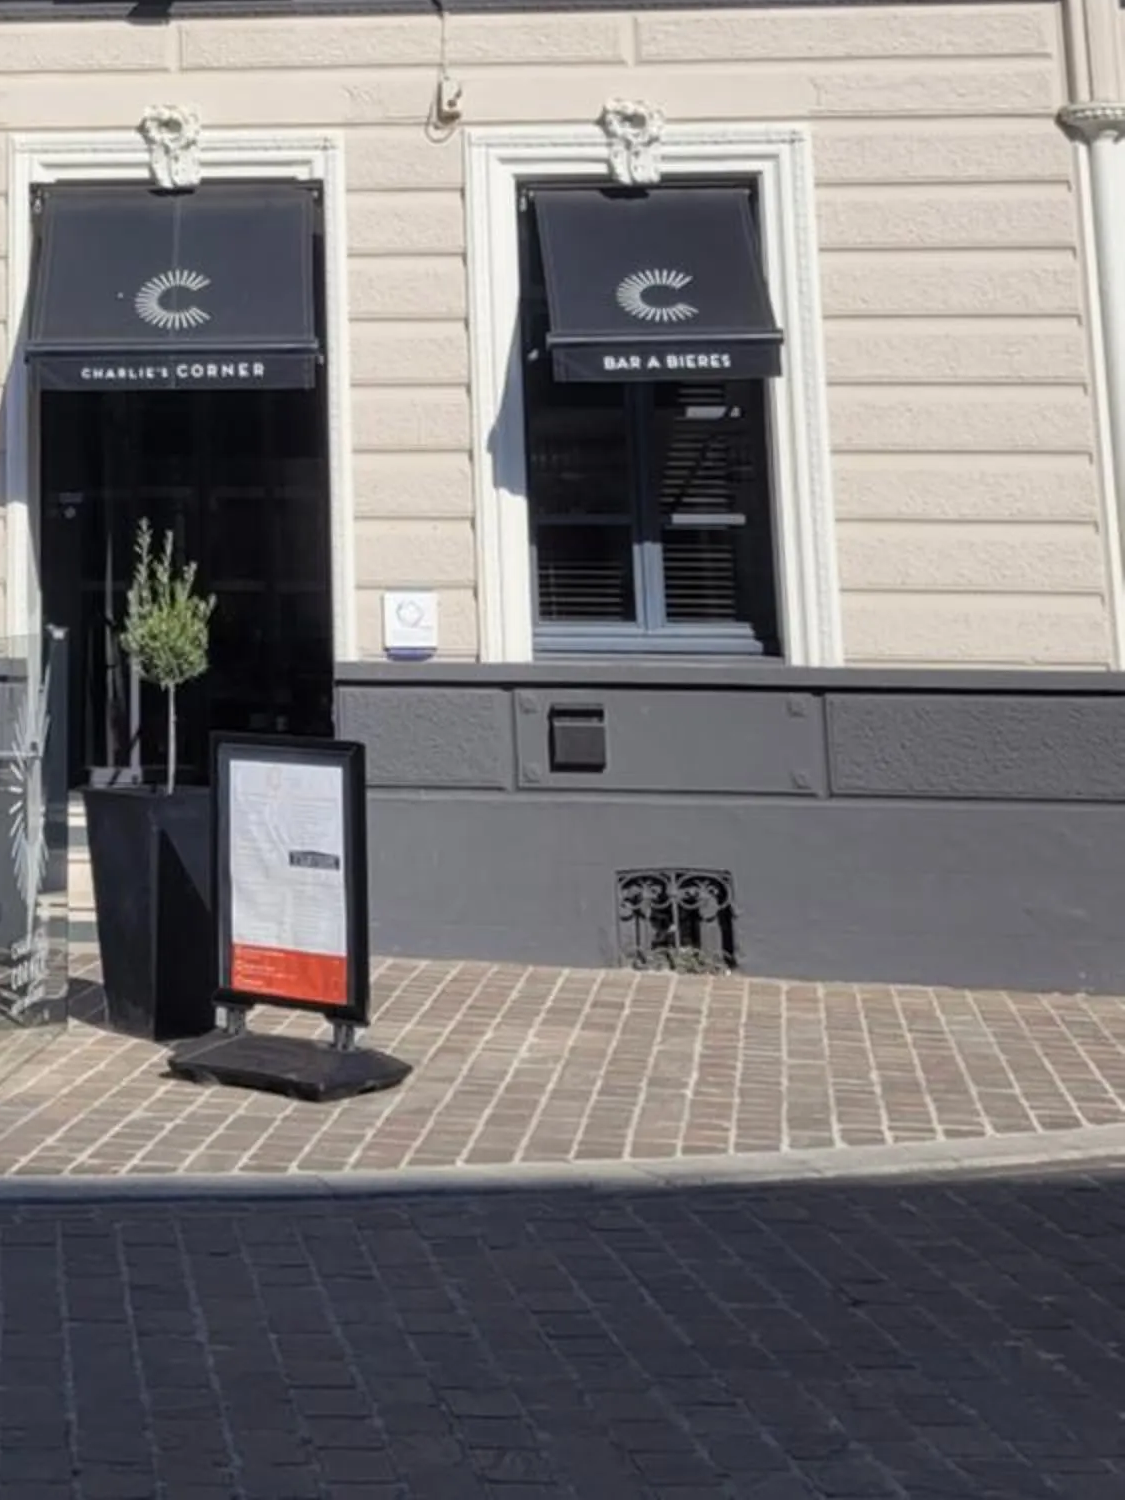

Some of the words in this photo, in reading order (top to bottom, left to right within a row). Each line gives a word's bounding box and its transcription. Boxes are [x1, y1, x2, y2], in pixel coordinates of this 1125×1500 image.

[177, 362, 265, 378] CORNER
[603, 356, 641, 370] BAR
[666, 354, 731, 369] BIERES
